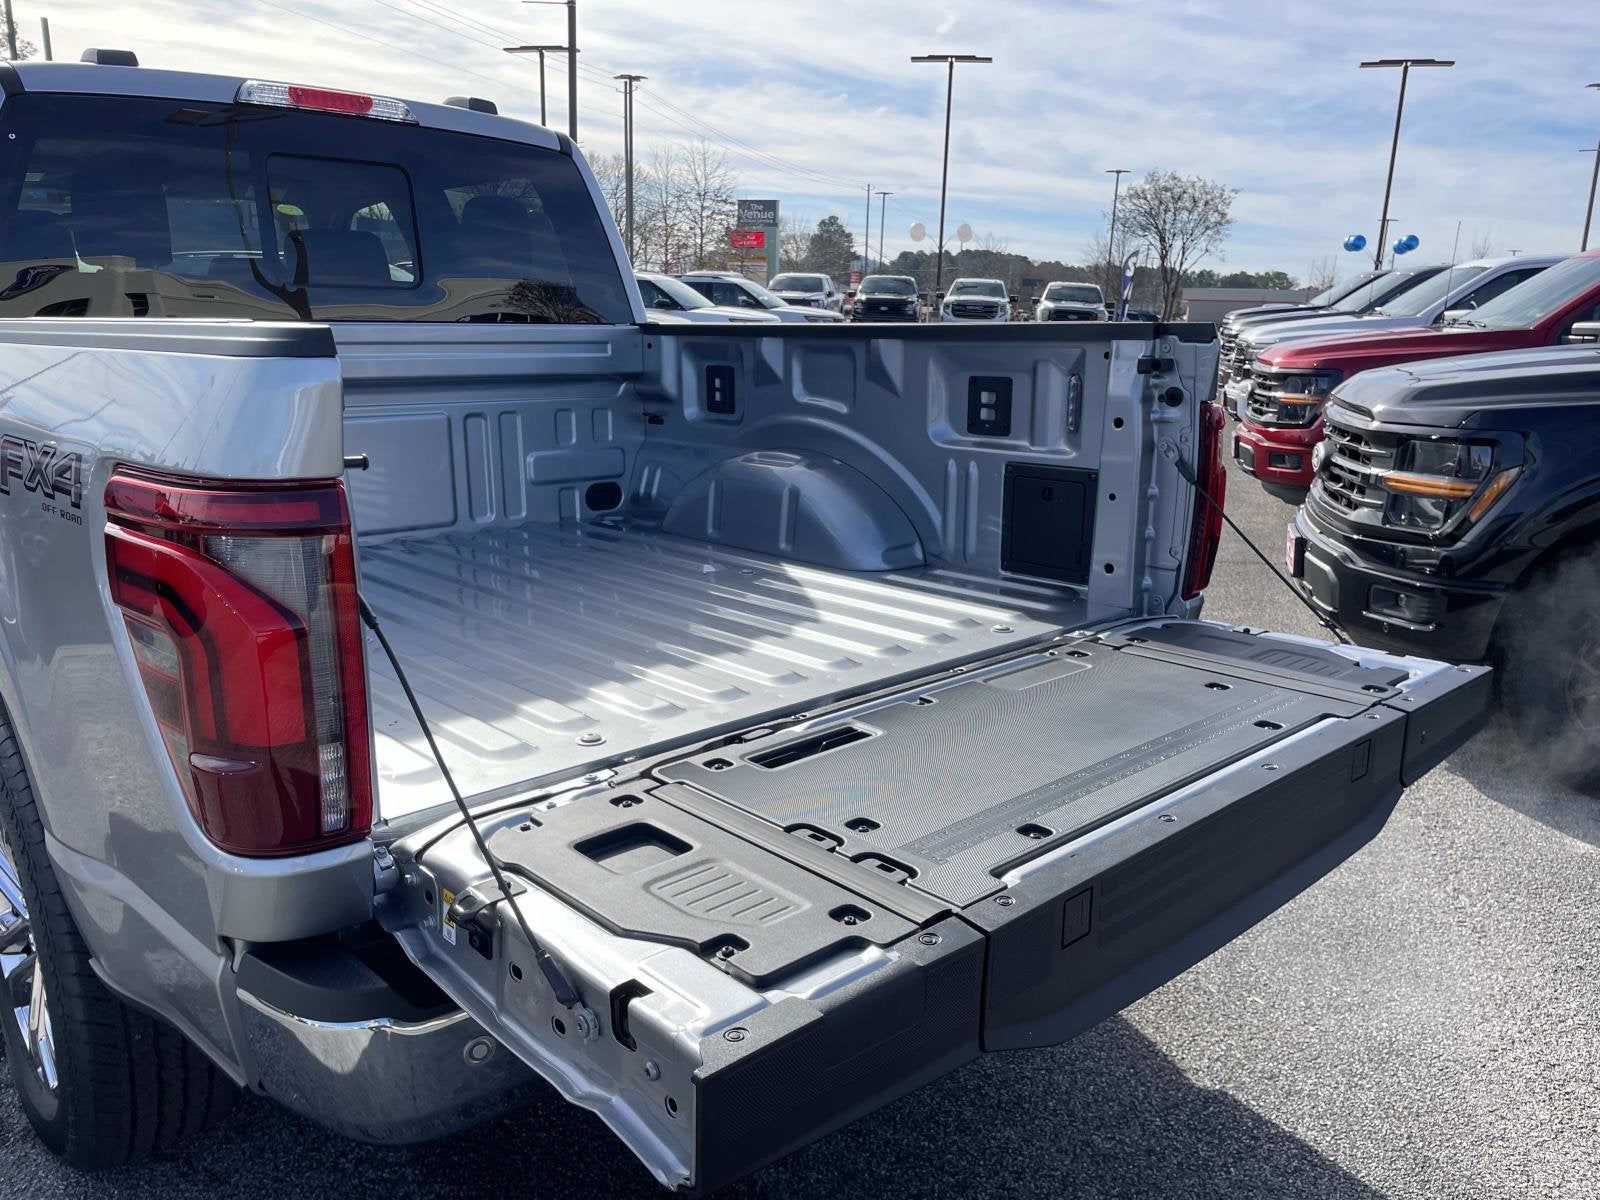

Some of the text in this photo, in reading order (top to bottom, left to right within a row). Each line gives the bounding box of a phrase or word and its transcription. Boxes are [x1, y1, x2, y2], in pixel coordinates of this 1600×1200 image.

[739, 208, 775, 219] Venue
[0, 433, 82, 510] FX4
[41, 502, 82, 525] OFF ROAD
